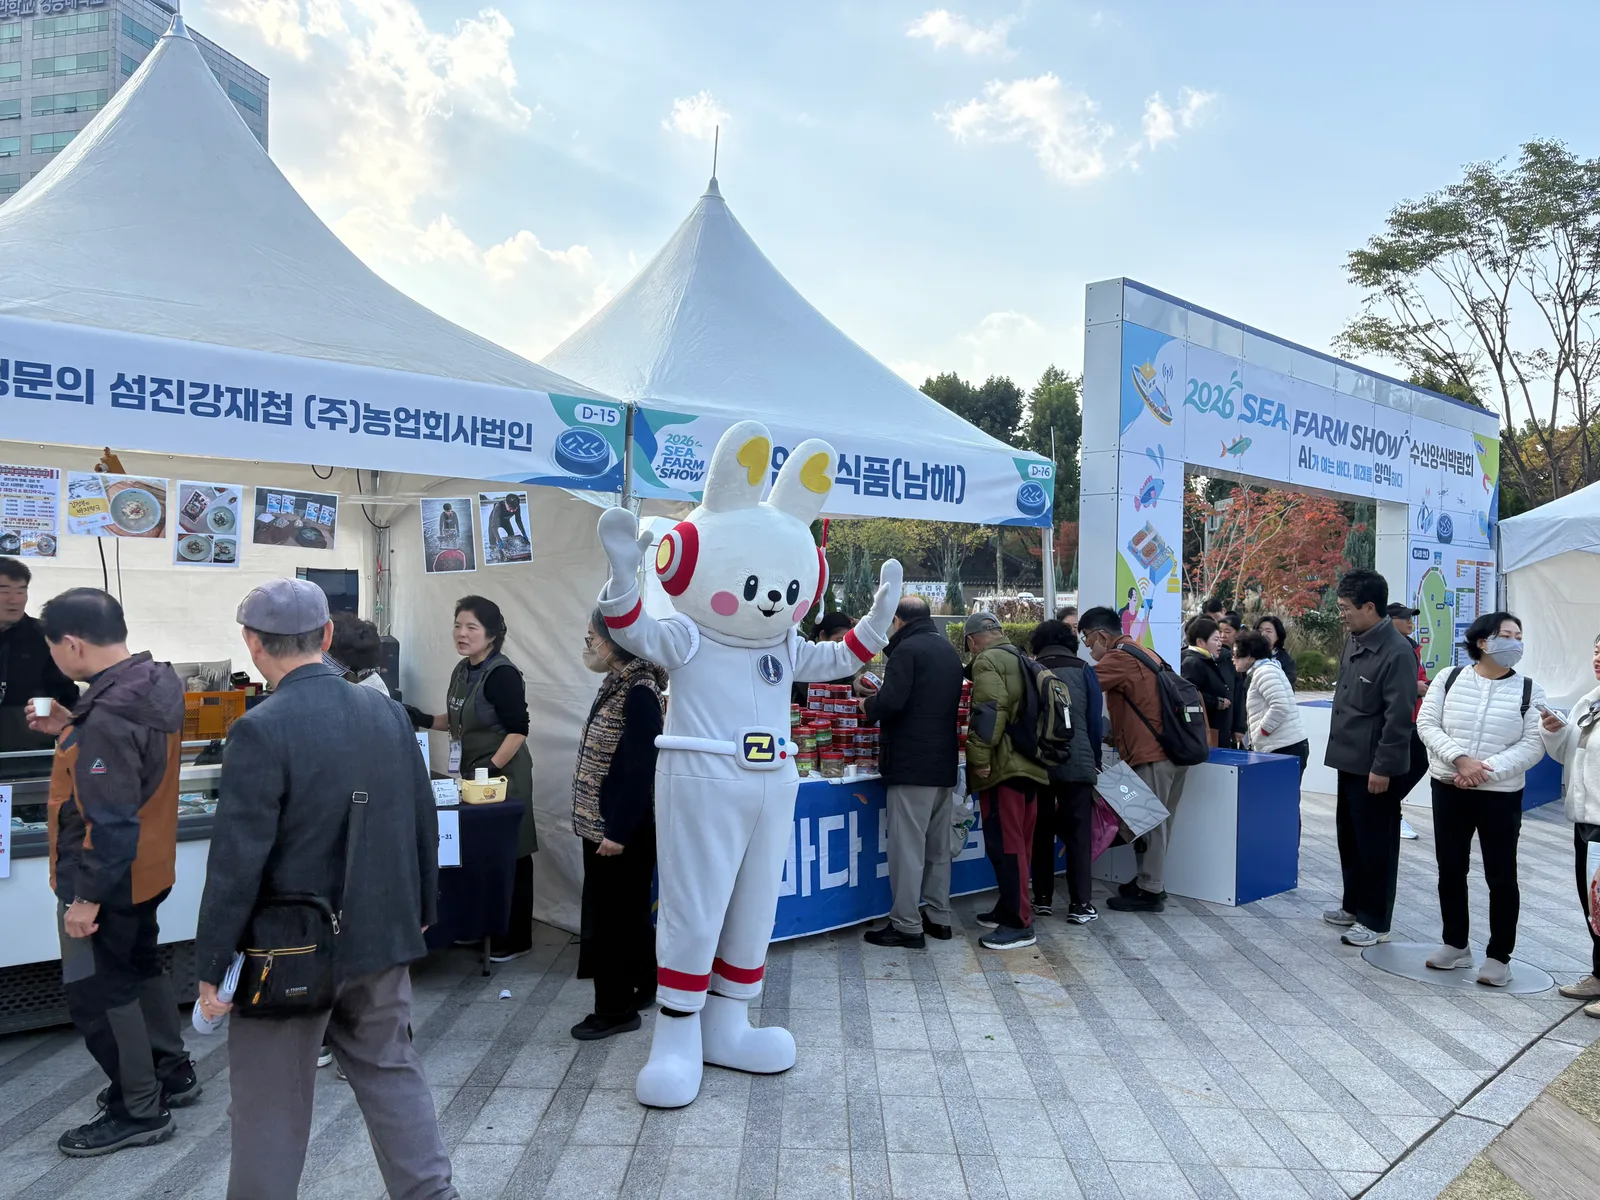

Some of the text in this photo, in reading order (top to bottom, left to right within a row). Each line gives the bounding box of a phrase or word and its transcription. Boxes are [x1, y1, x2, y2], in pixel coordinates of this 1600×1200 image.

[0, 358, 532, 452] 문의 섬진강재첩 (주)농업회사법인
[582, 405, 616, 423] D-15
[1183, 377, 1474, 478] 2026 SEA FARM SHOW 수산양식박람회
[664, 433, 695, 447] 2026
[661, 445, 696, 458] SEA
[661, 457, 705, 471] FARM
[658, 468, 705, 482] SHOW
[1032, 465, 1051, 478] D-16
